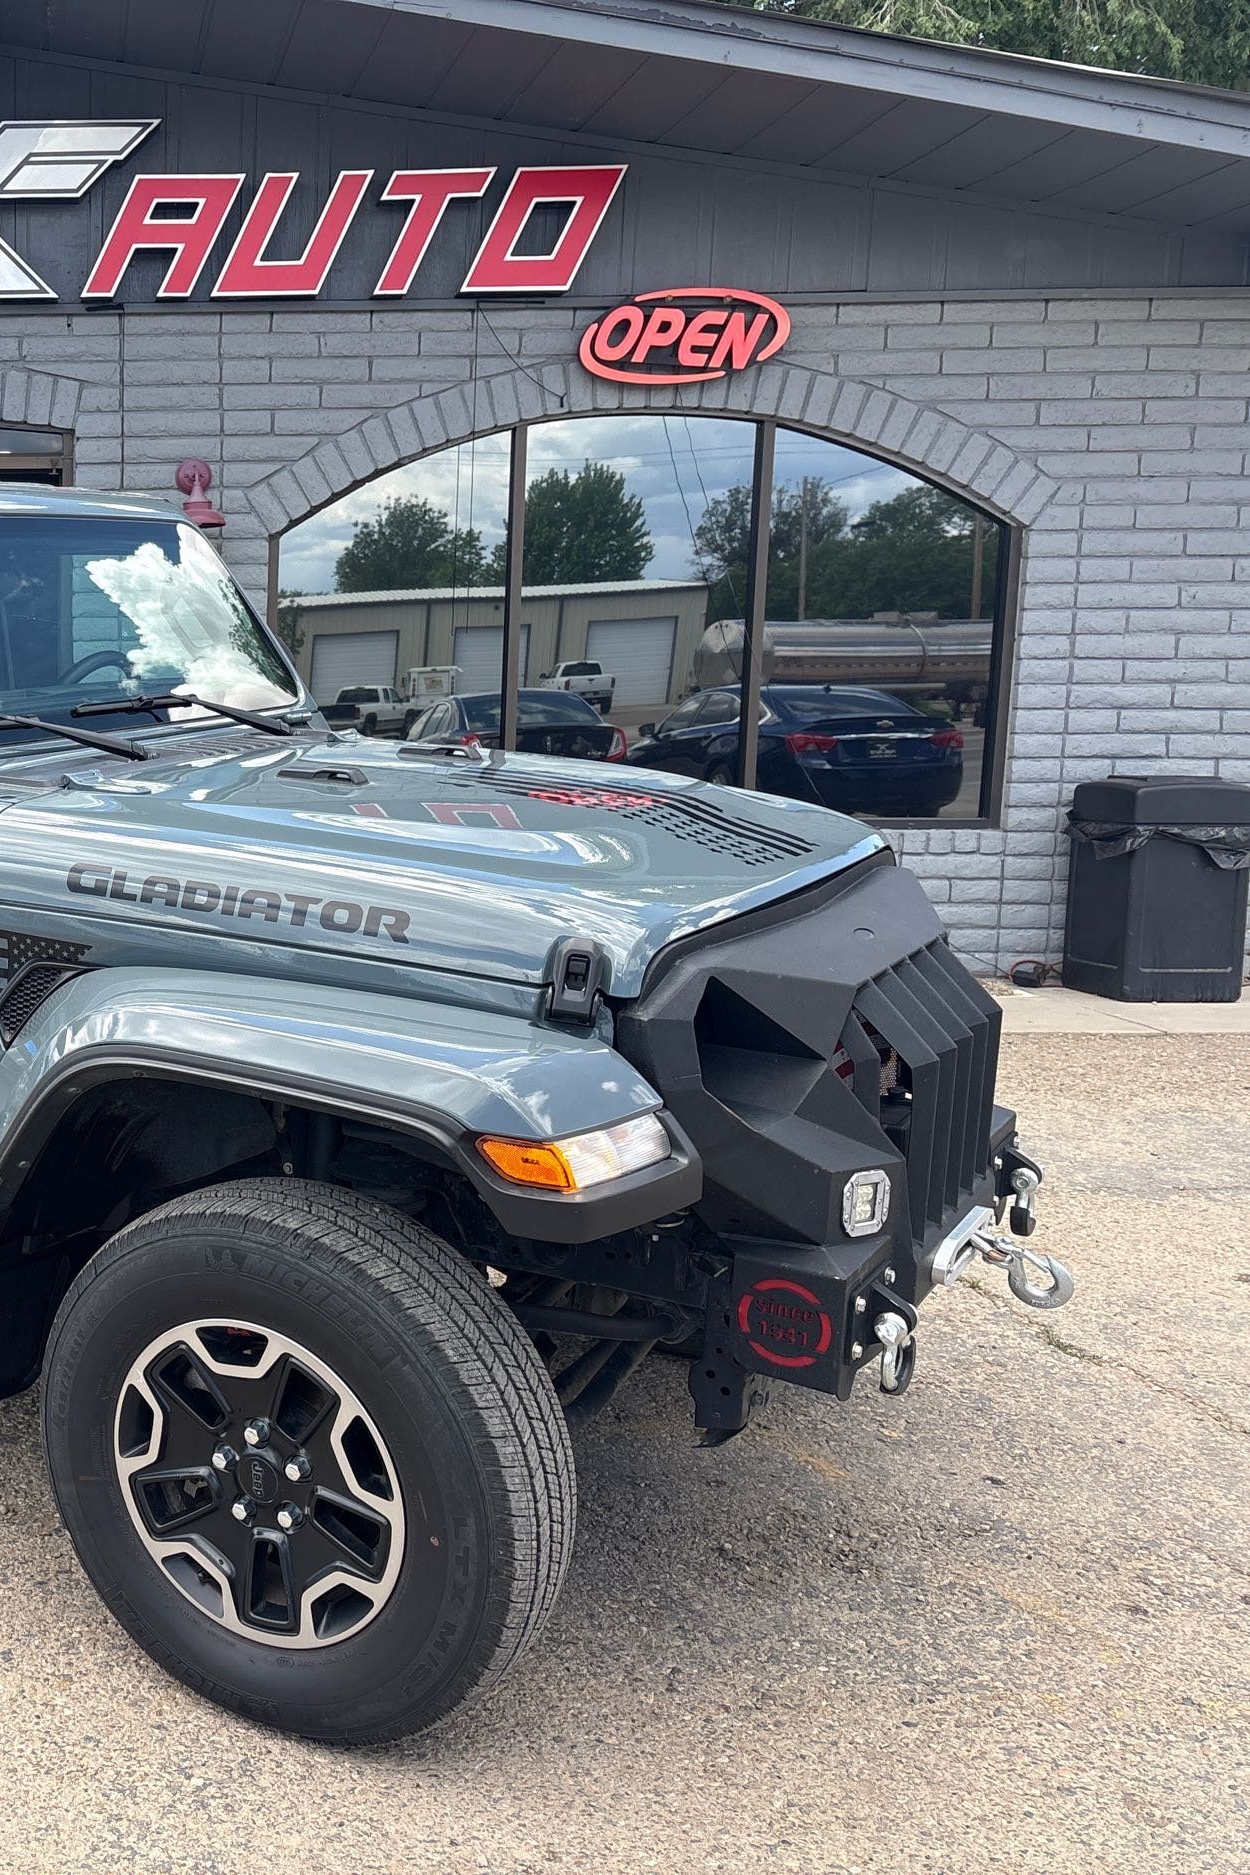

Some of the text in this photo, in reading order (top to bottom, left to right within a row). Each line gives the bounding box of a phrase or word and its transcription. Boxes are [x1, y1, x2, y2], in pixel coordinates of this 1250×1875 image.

[81, 164, 629, 299] AUTO
[592, 304, 770, 370] OPEN
[66, 862, 412, 944] GLADIATOR
[242, 1252, 401, 1372] MICHELIN
[755, 1296, 815, 1323] since
[758, 1320, 811, 1346] 1941
[251, 1461, 265, 1498] Jeep
[448, 1513, 472, 1606] LTX
